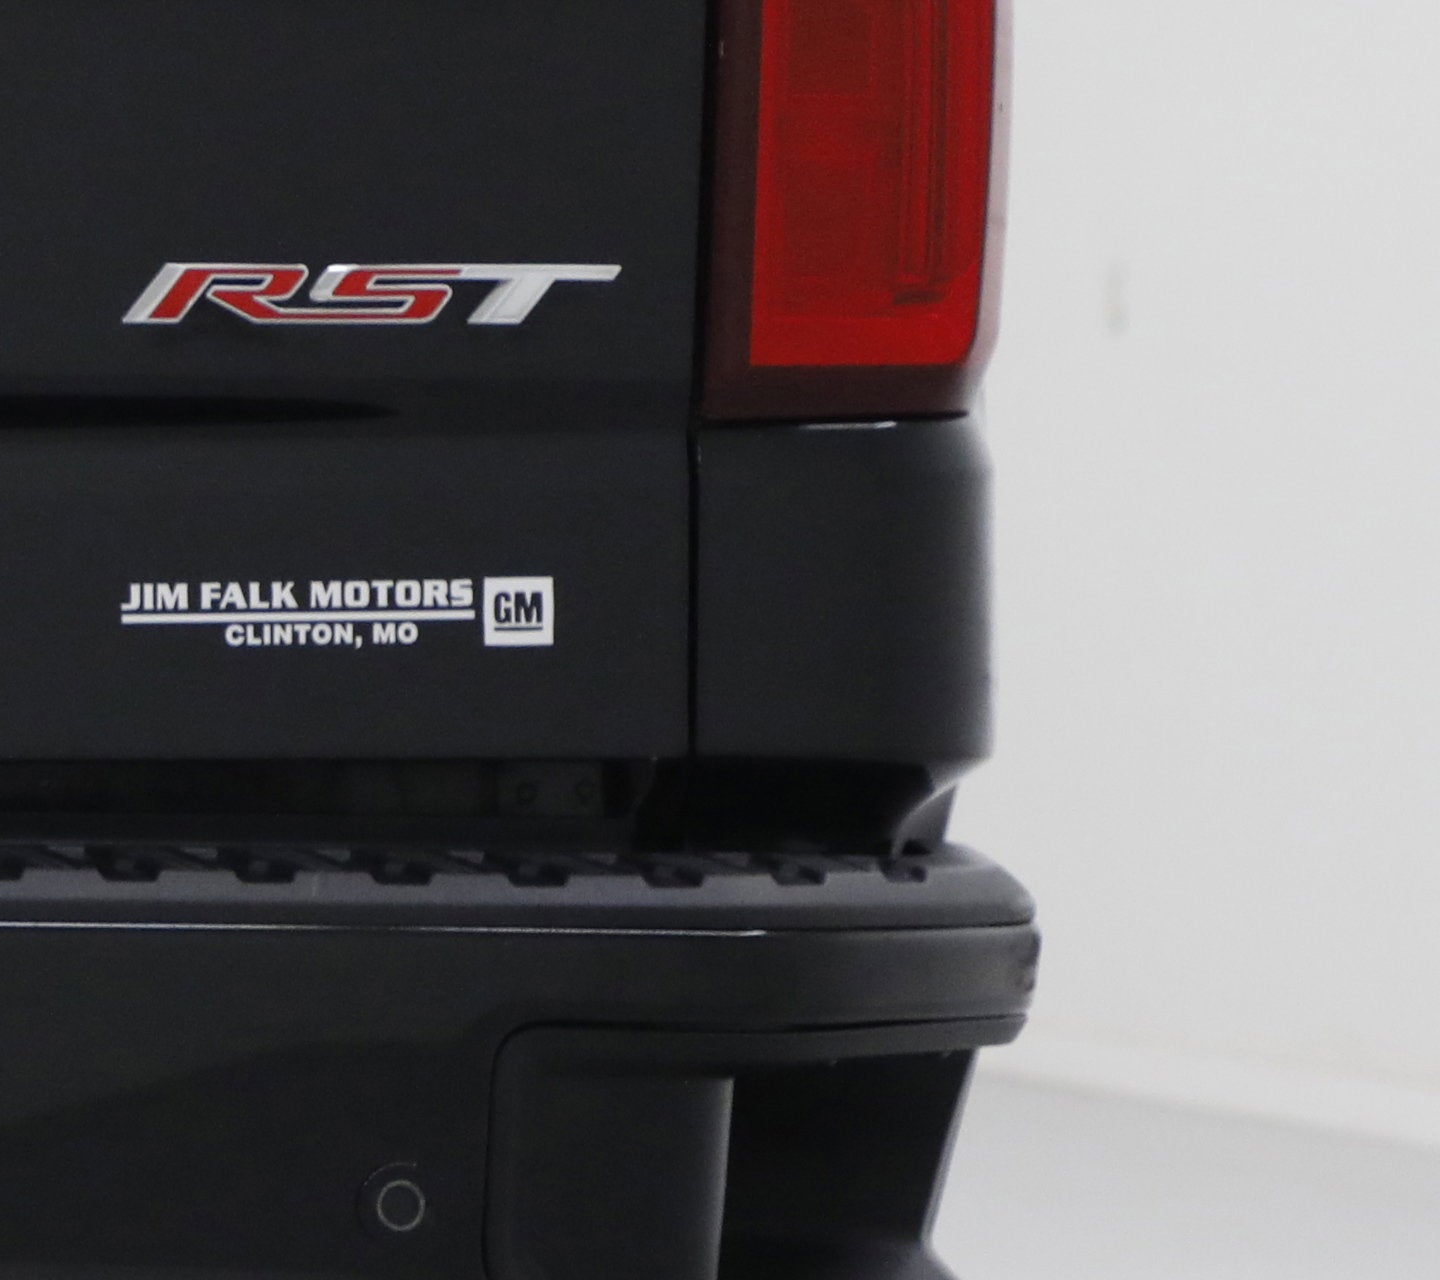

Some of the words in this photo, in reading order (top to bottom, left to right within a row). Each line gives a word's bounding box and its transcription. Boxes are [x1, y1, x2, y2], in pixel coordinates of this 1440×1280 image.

[122, 262, 622, 324] RST
[121, 583, 188, 611] JIM
[200, 581, 298, 610] FALK
[309, 579, 473, 608] MOTORS
[492, 591, 543, 625] GM
[225, 623, 363, 650] CLINTON,
[372, 622, 418, 645] MO
